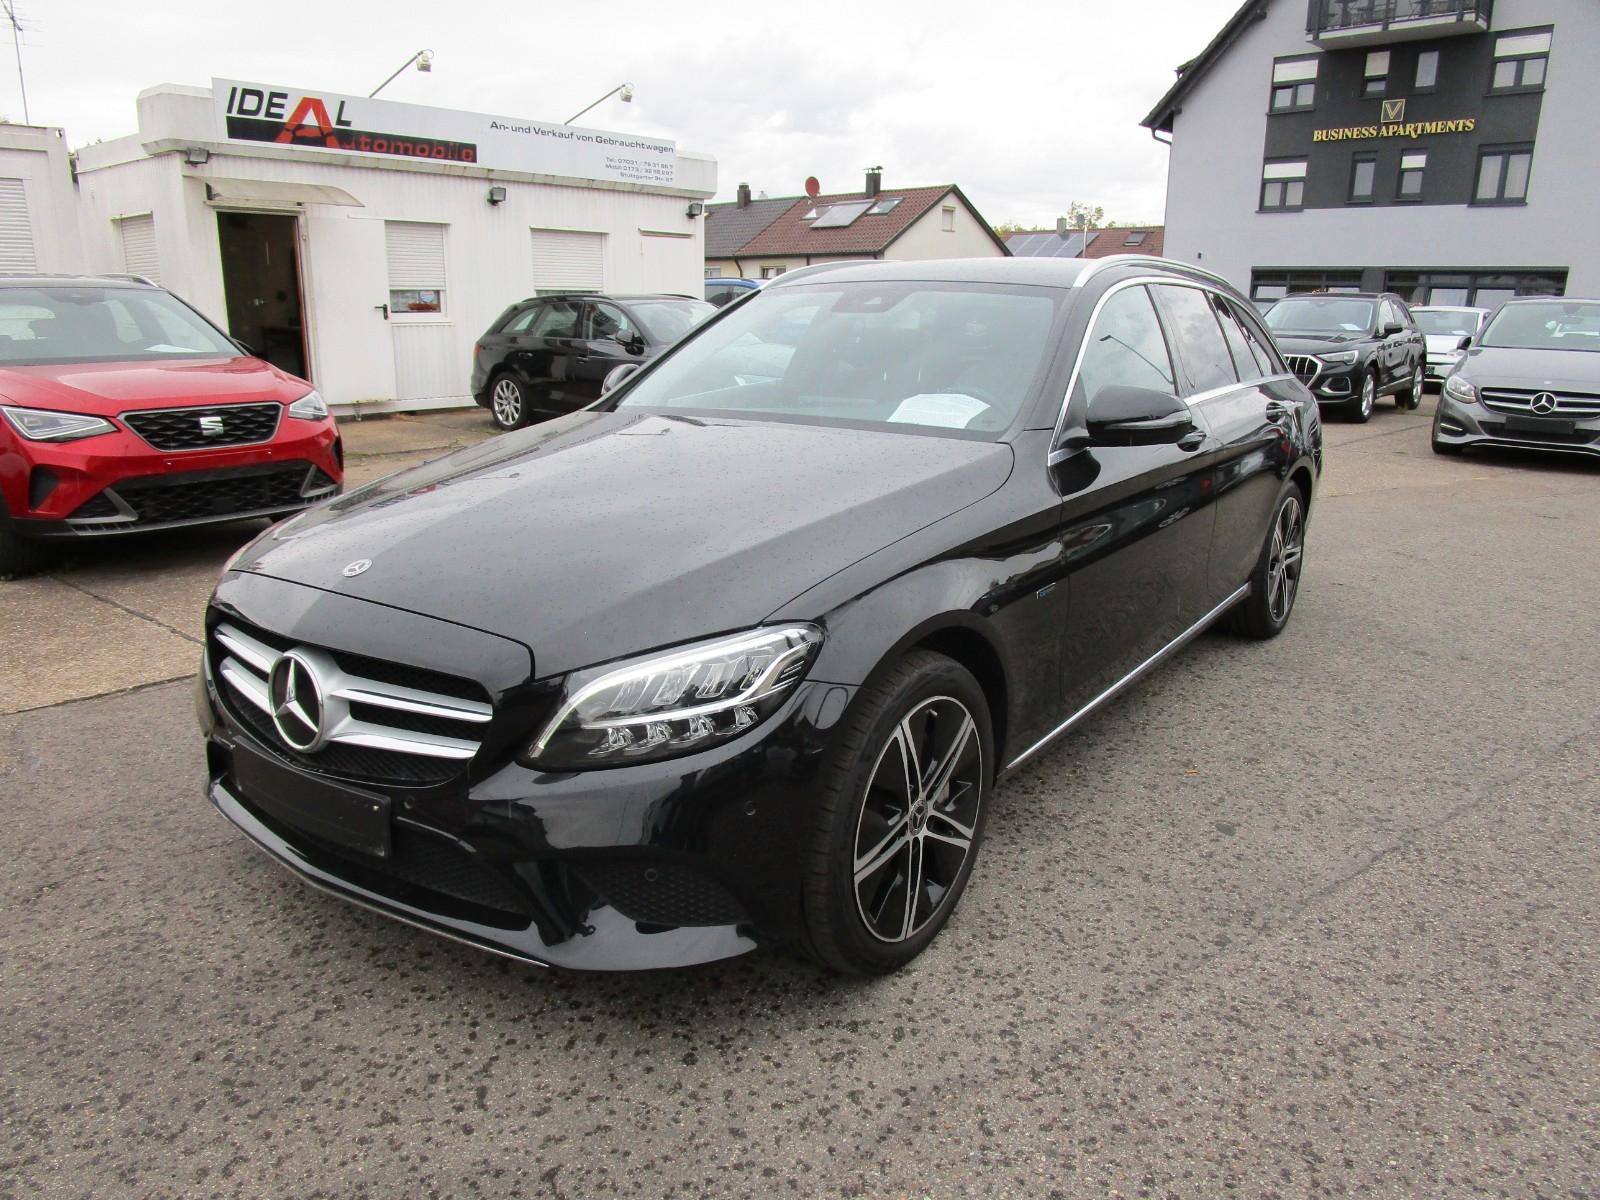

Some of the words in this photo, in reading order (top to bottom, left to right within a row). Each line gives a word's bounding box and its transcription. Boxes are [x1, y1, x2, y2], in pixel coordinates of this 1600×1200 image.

[227, 86, 353, 149] IDEAL
[1313, 125, 1378, 142] BUSINESS
[1379, 119, 1475, 139] APARTMENTS
[490, 121, 509, 131] An-
[511, 125, 531, 134] und
[533, 127, 575, 140] Verkauf
[576, 135, 594, 143] von
[595, 135, 674, 153] Gebrauchtwagen
